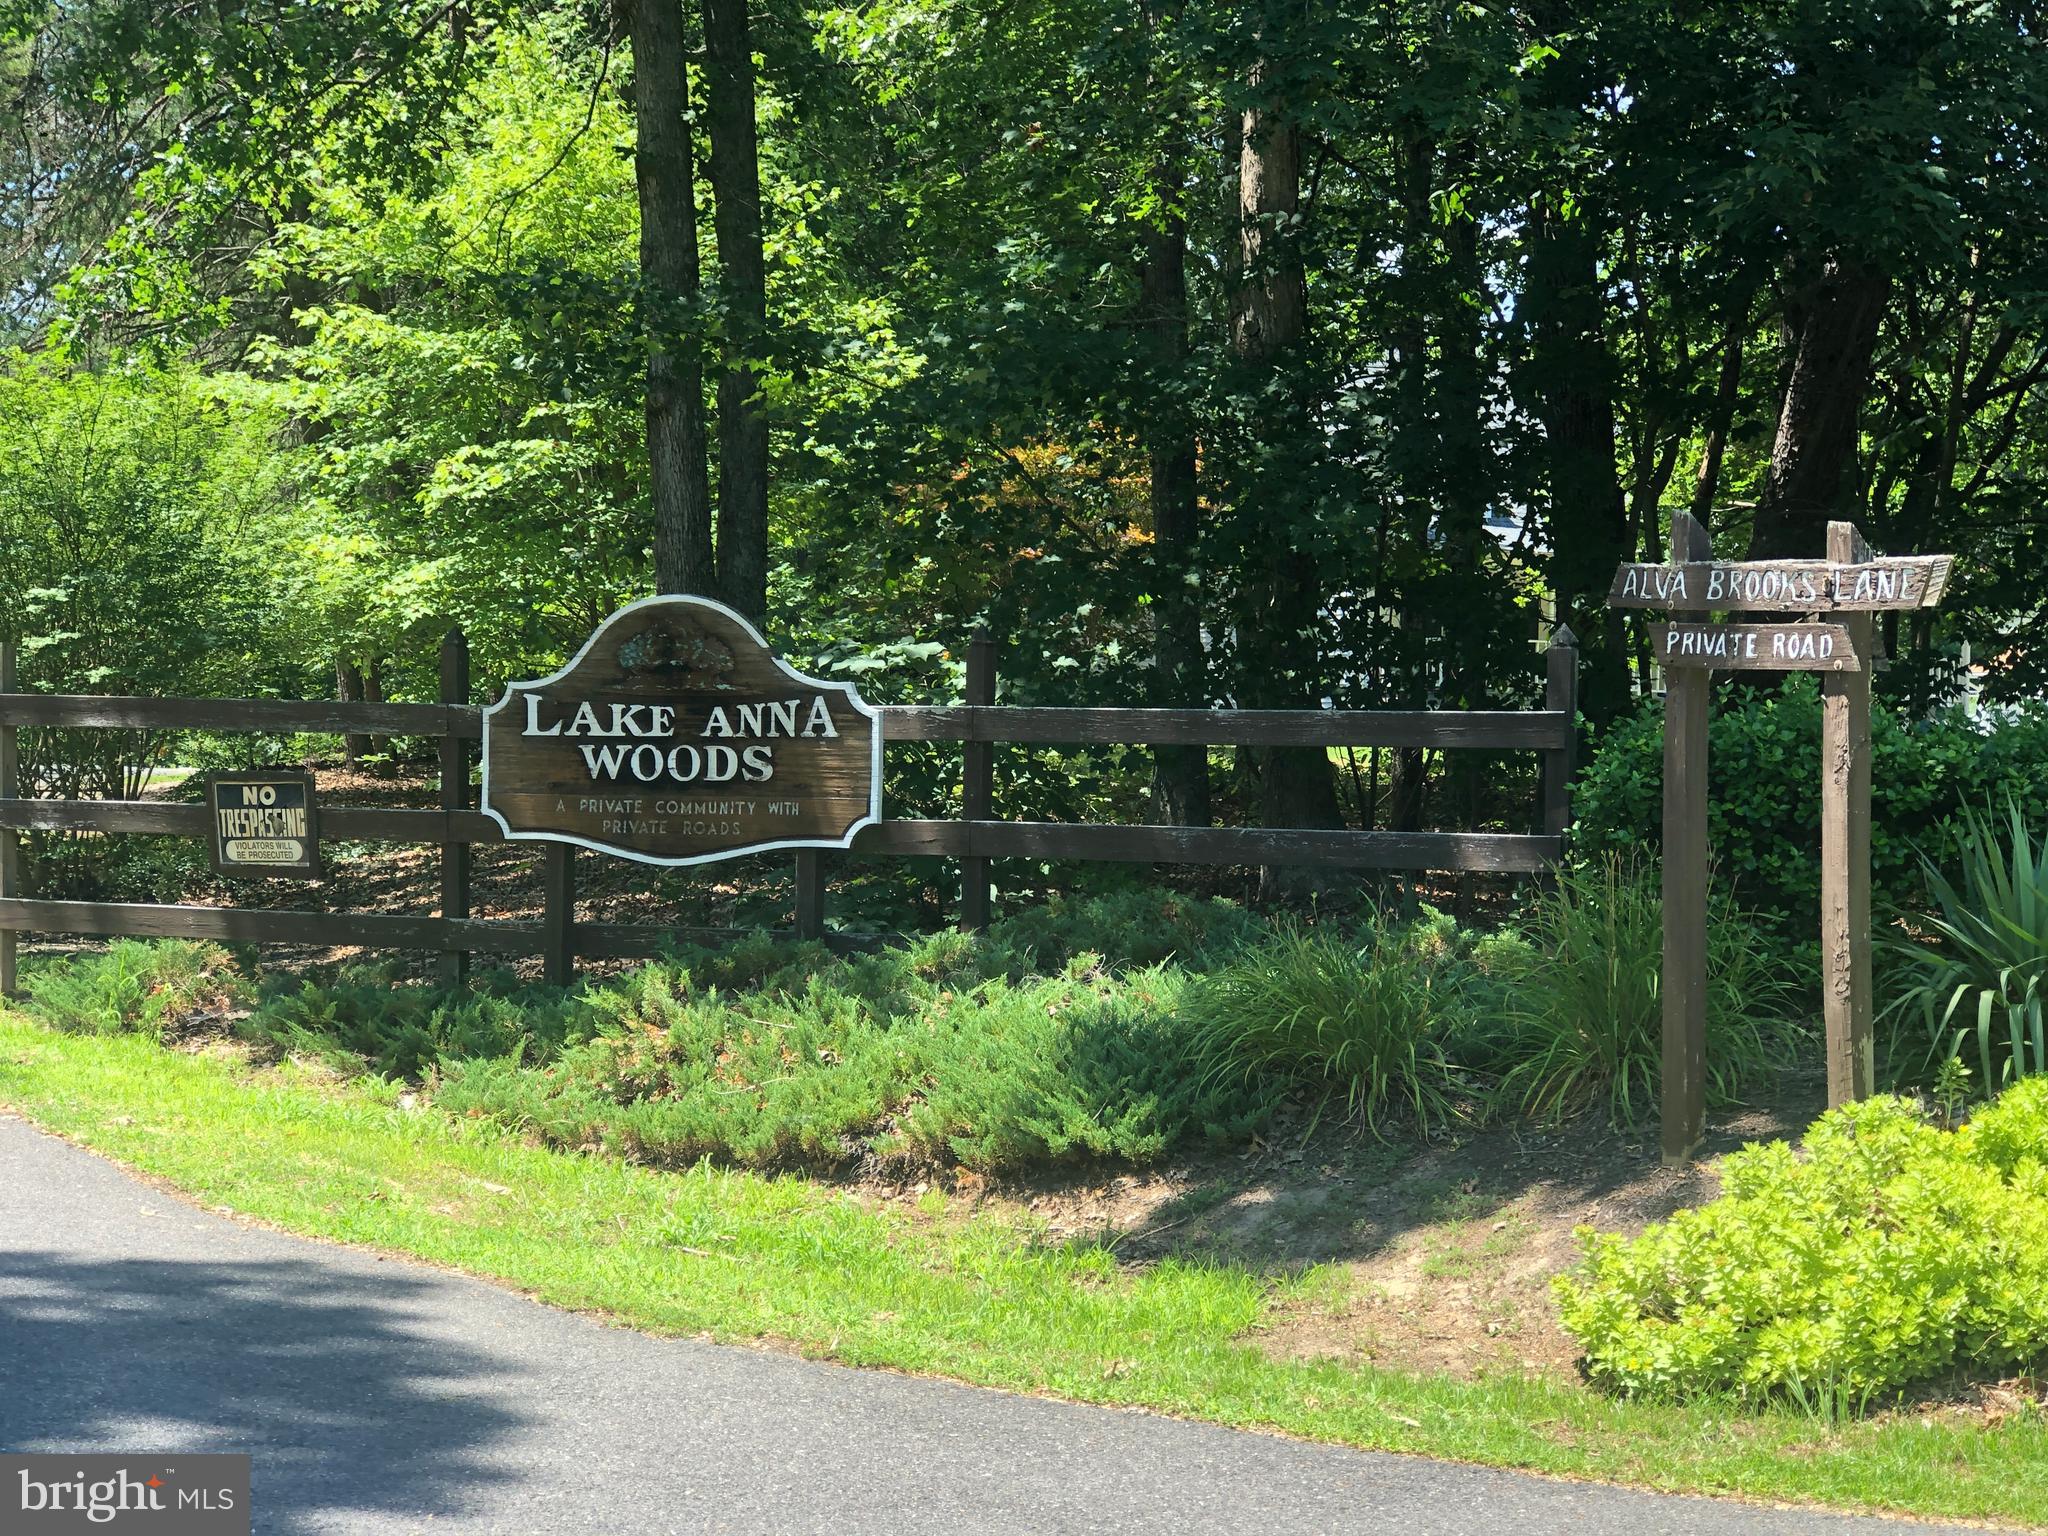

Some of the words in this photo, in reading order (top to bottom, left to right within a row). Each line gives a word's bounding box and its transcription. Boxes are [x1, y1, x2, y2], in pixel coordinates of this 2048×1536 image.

[1622, 569, 1688, 600] ALVA
[1707, 569, 1815, 602] BROOKS
[1834, 569, 1917, 601] LANE
[1666, 632, 1758, 659] PRIVATE
[1773, 633, 1834, 660] ROAD
[521, 694, 676, 737] LAKE
[700, 695, 839, 738] ANNA
[579, 744, 774, 782] WOODS
[242, 785, 276, 806] NO
[556, 800, 565, 812] A
[580, 800, 643, 814] PRIVATE
[655, 800, 757, 816] COMMUNITY
[767, 802, 799, 815] WITH
[602, 820, 668, 834] PRIVATE
[683, 822, 741, 835] ROADS
[235, 842, 275, 850] VIOLATORS
[276, 842, 293, 850] WILL
[236, 851, 246, 859] BE
[248, 851, 294, 859] PROSECUTED
